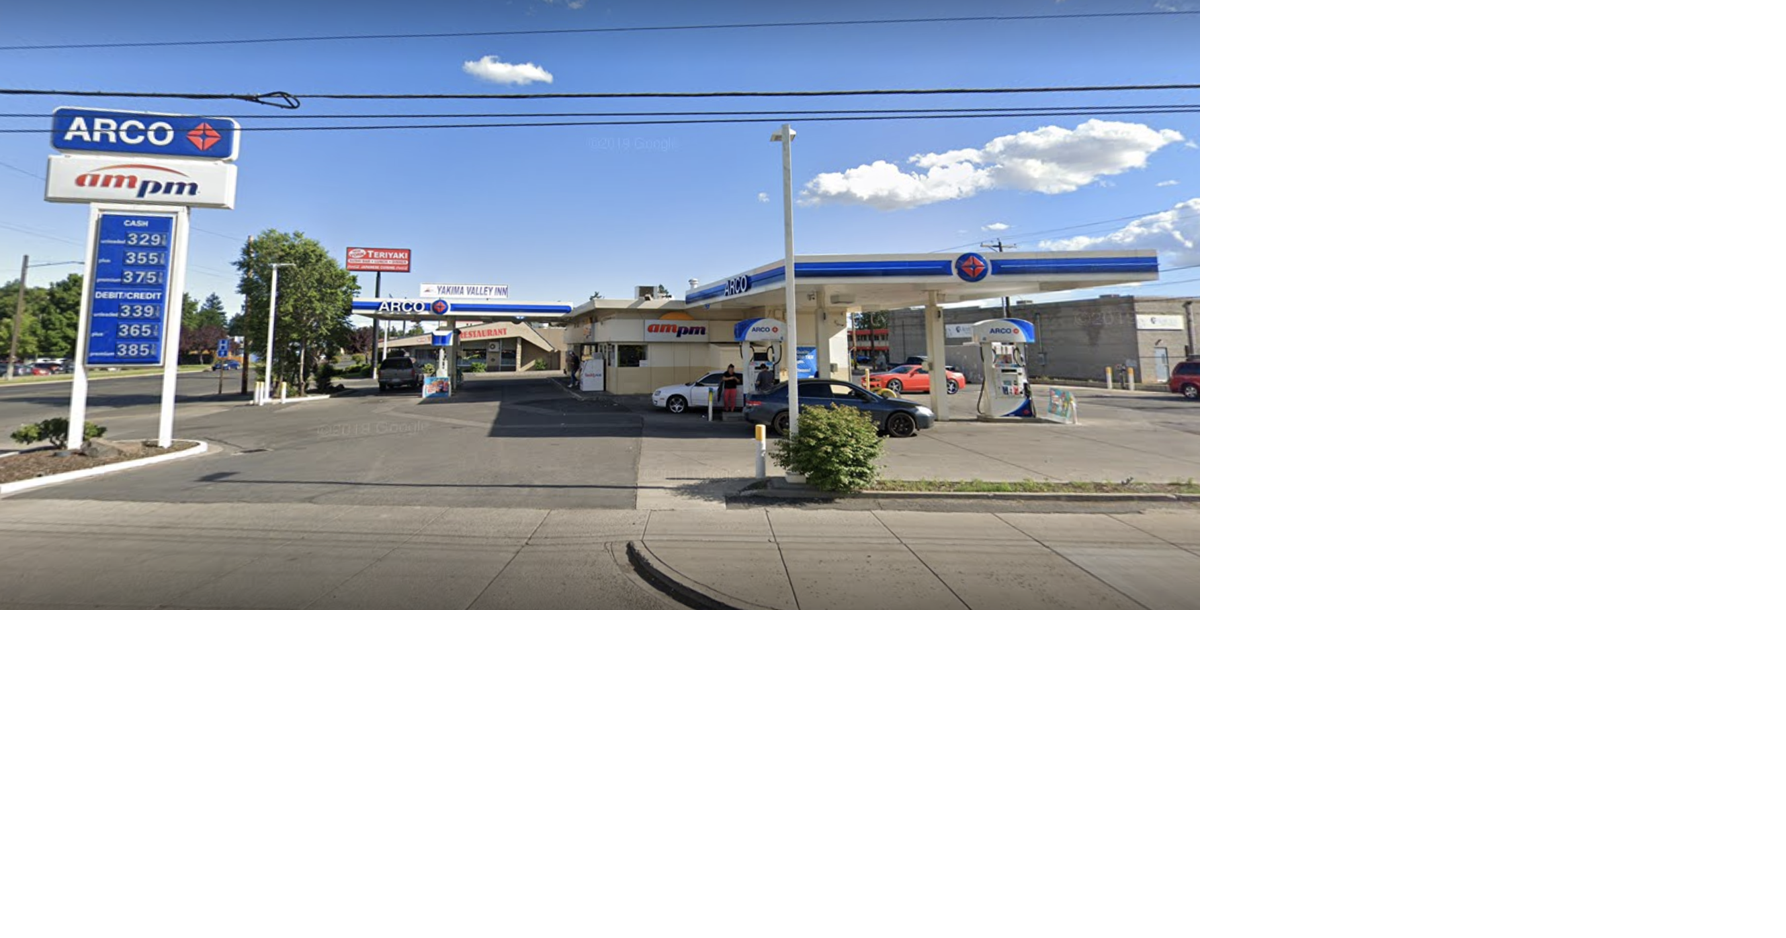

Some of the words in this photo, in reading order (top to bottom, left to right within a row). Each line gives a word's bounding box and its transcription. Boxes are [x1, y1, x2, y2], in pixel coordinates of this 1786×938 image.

[63, 116, 175, 146] ARCO
[75, 172, 199, 198] ampm
[123, 219, 149, 227] CASH
[127, 233, 161, 246] 329
[125, 251, 159, 265] 355
[367, 250, 408, 259] TERIYAKI
[123, 270, 157, 284] 375
[437, 285, 464, 296] YAKIMA
[466, 285, 493, 297] VALLEY
[494, 286, 508, 297] INN
[724, 275, 748, 297] ARCO
[120, 304, 155, 318] 339
[378, 301, 426, 313] ARCO
[118, 324, 152, 337] 365
[459, 328, 508, 339] RESTAURANT
[647, 324, 706, 338] ampm
[117, 343, 150, 357] 385
